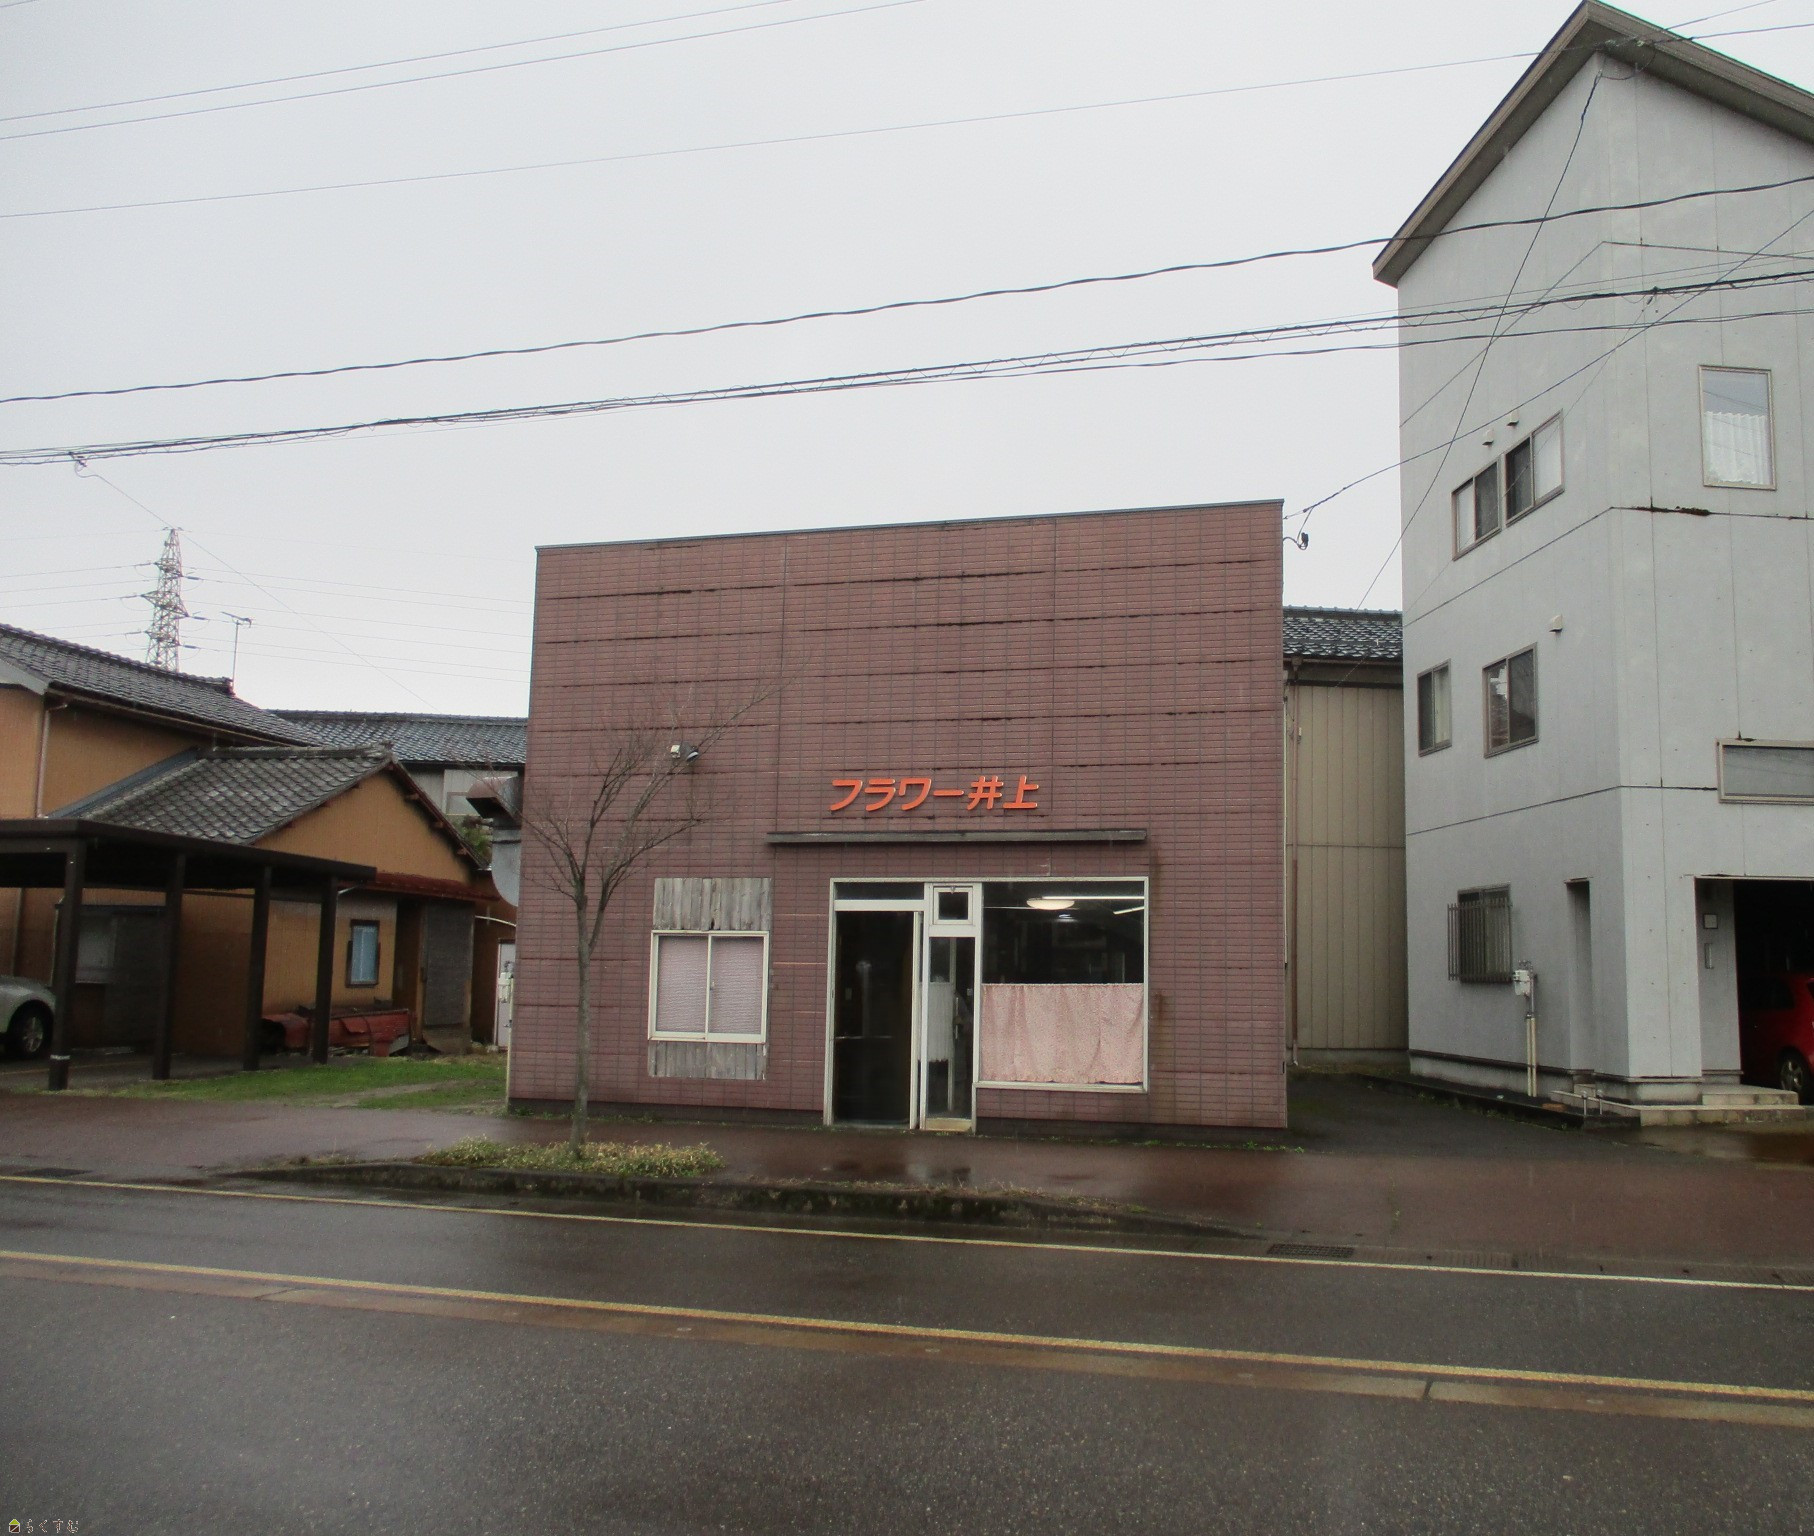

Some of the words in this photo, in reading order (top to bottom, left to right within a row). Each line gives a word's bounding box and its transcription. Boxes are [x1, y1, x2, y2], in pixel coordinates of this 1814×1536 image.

[830, 775, 1039, 811] フラワー井上
